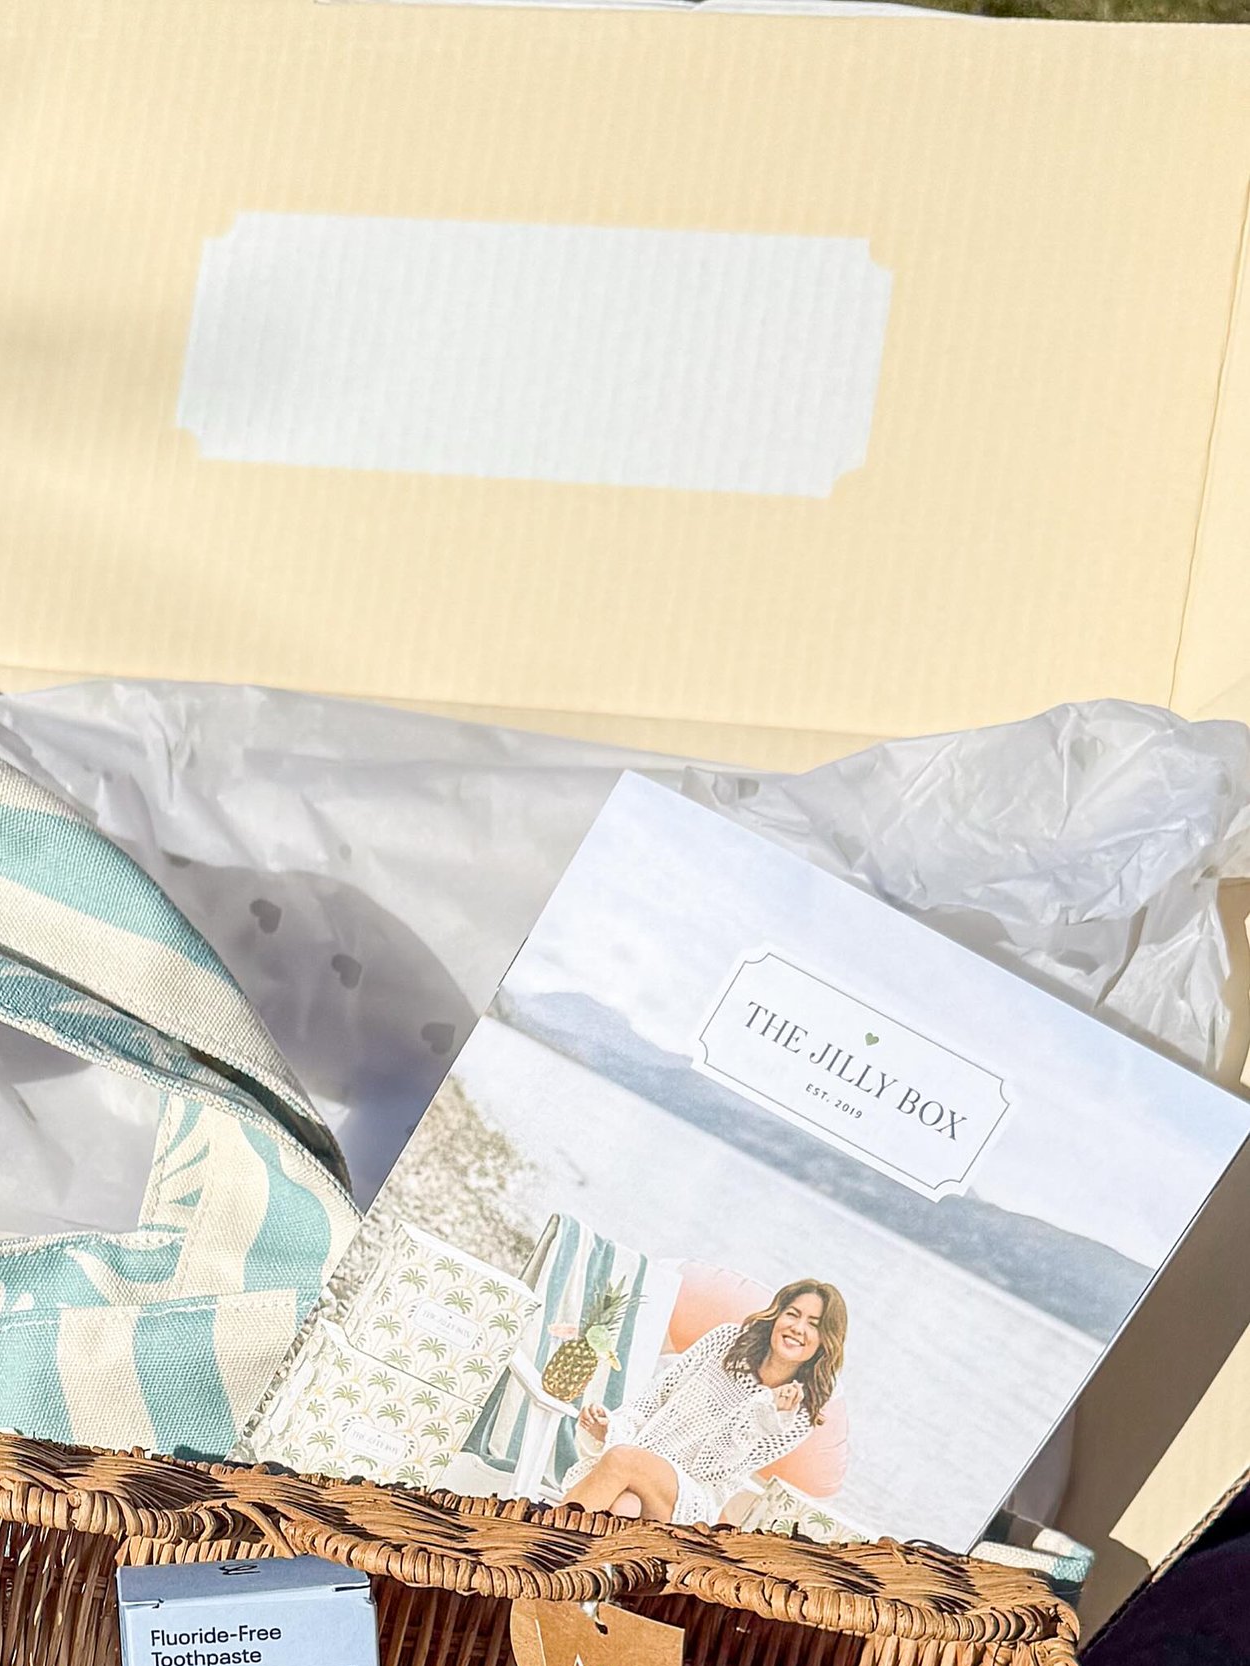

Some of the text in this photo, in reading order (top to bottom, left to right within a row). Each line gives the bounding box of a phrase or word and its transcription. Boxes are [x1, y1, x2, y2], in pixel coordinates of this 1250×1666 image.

[743, 1000, 968, 1141] THE JILLY BOX
[805, 1083, 864, 1120] EST. 2019
[150, 1625, 282, 1647] Fluoride-Free
